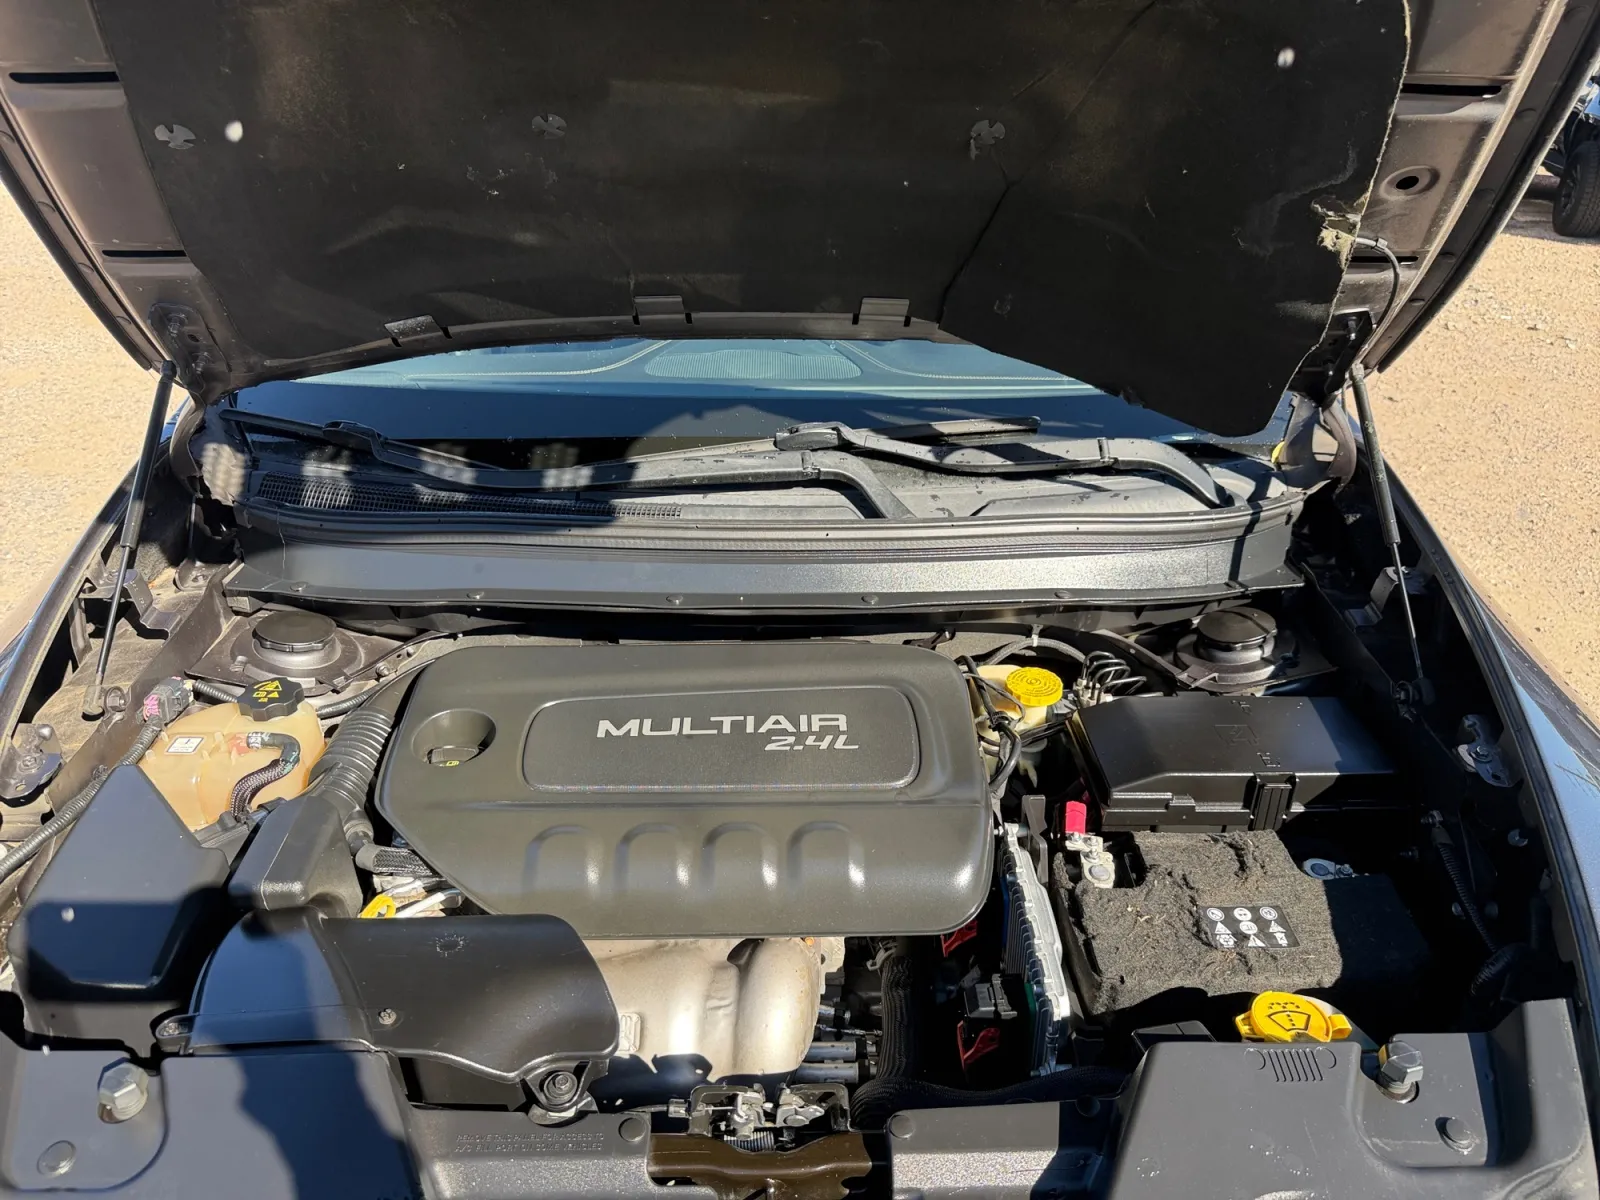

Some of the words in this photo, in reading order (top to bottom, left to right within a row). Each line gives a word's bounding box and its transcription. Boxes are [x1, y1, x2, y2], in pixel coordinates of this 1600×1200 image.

[597, 714, 848, 738] MULTIAIR
[764, 734, 859, 751] 2.4L
[559, 1133, 593, 1141] ACCESS
[595, 1133, 604, 1141] TO
